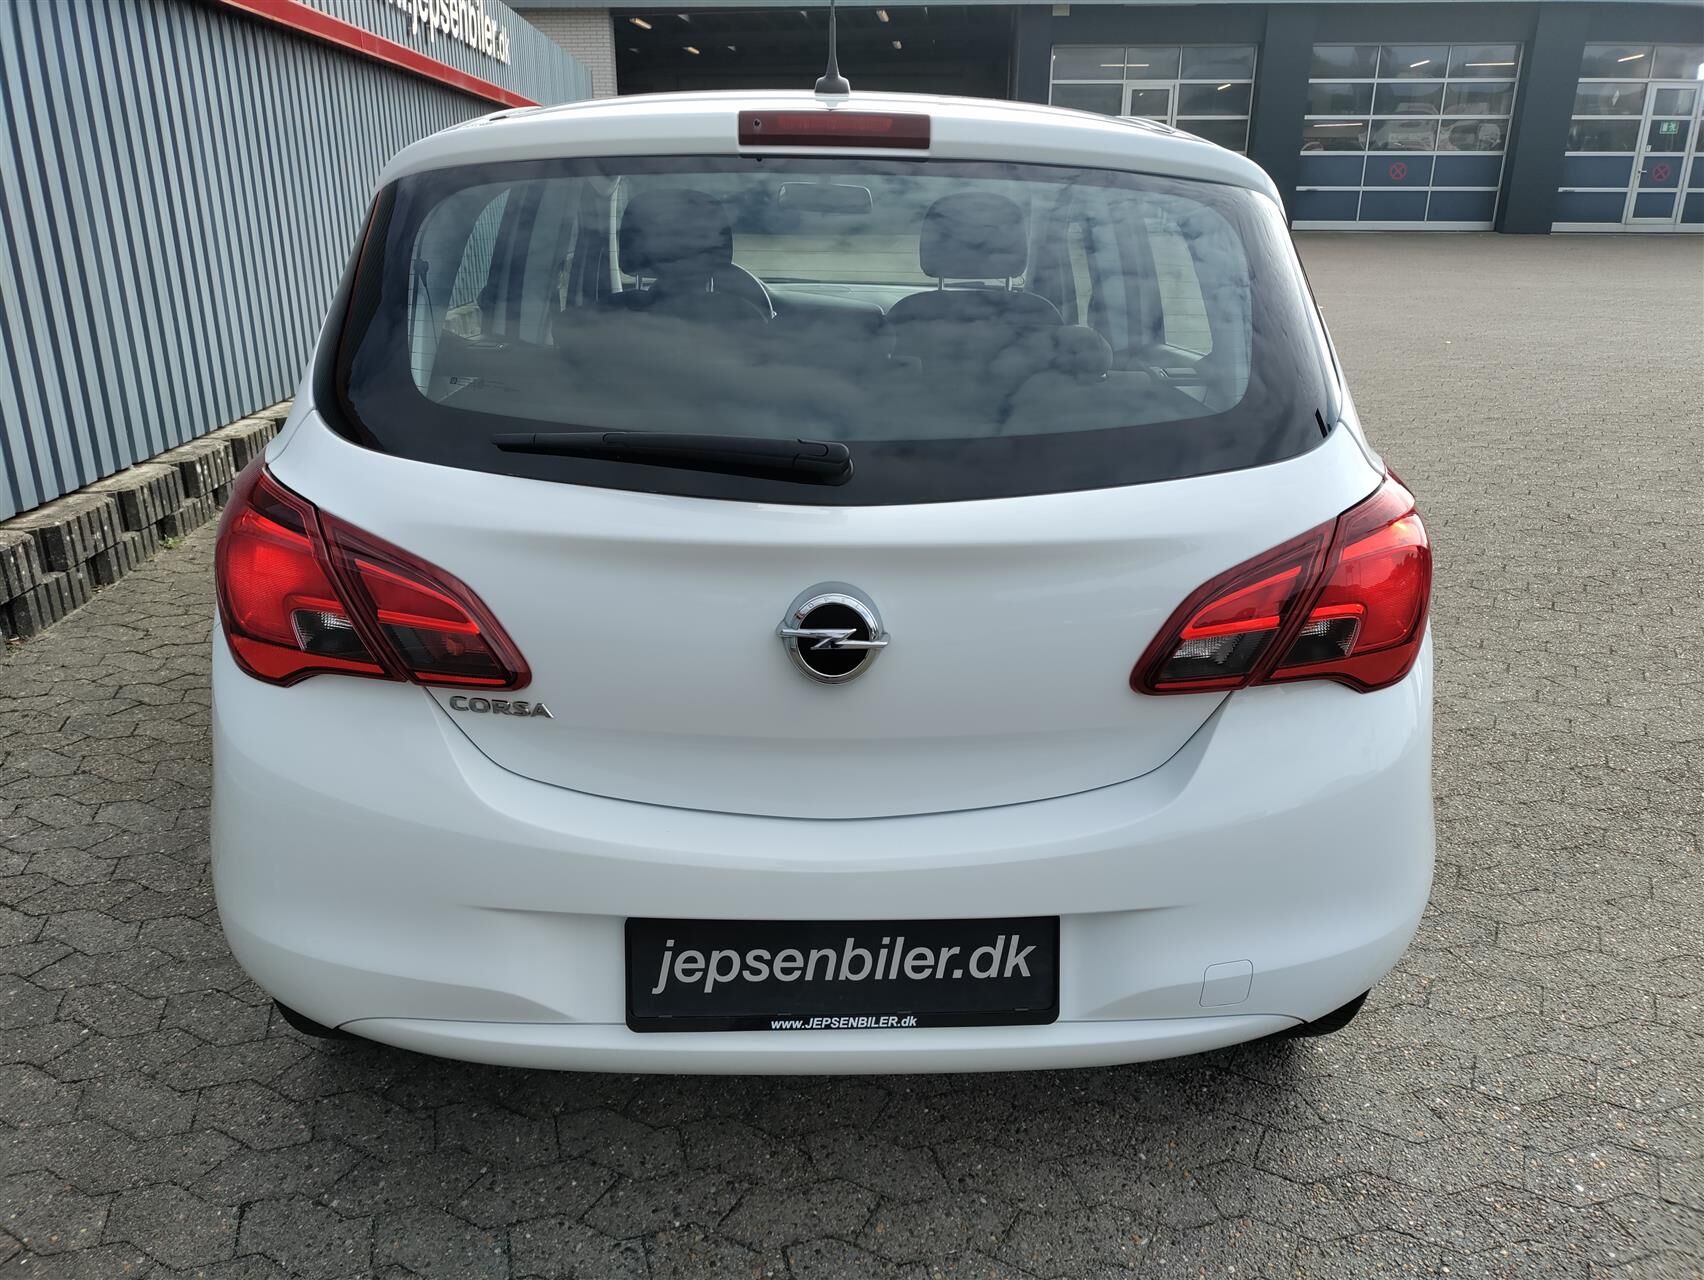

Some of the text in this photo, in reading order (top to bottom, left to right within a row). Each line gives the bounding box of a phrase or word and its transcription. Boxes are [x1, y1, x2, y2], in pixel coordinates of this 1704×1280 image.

[449, 695, 554, 718] CORSA
[651, 934, 1037, 994] jepsenbiler.dk
[771, 1016, 917, 1030] www.JEPSENBILER.dk
